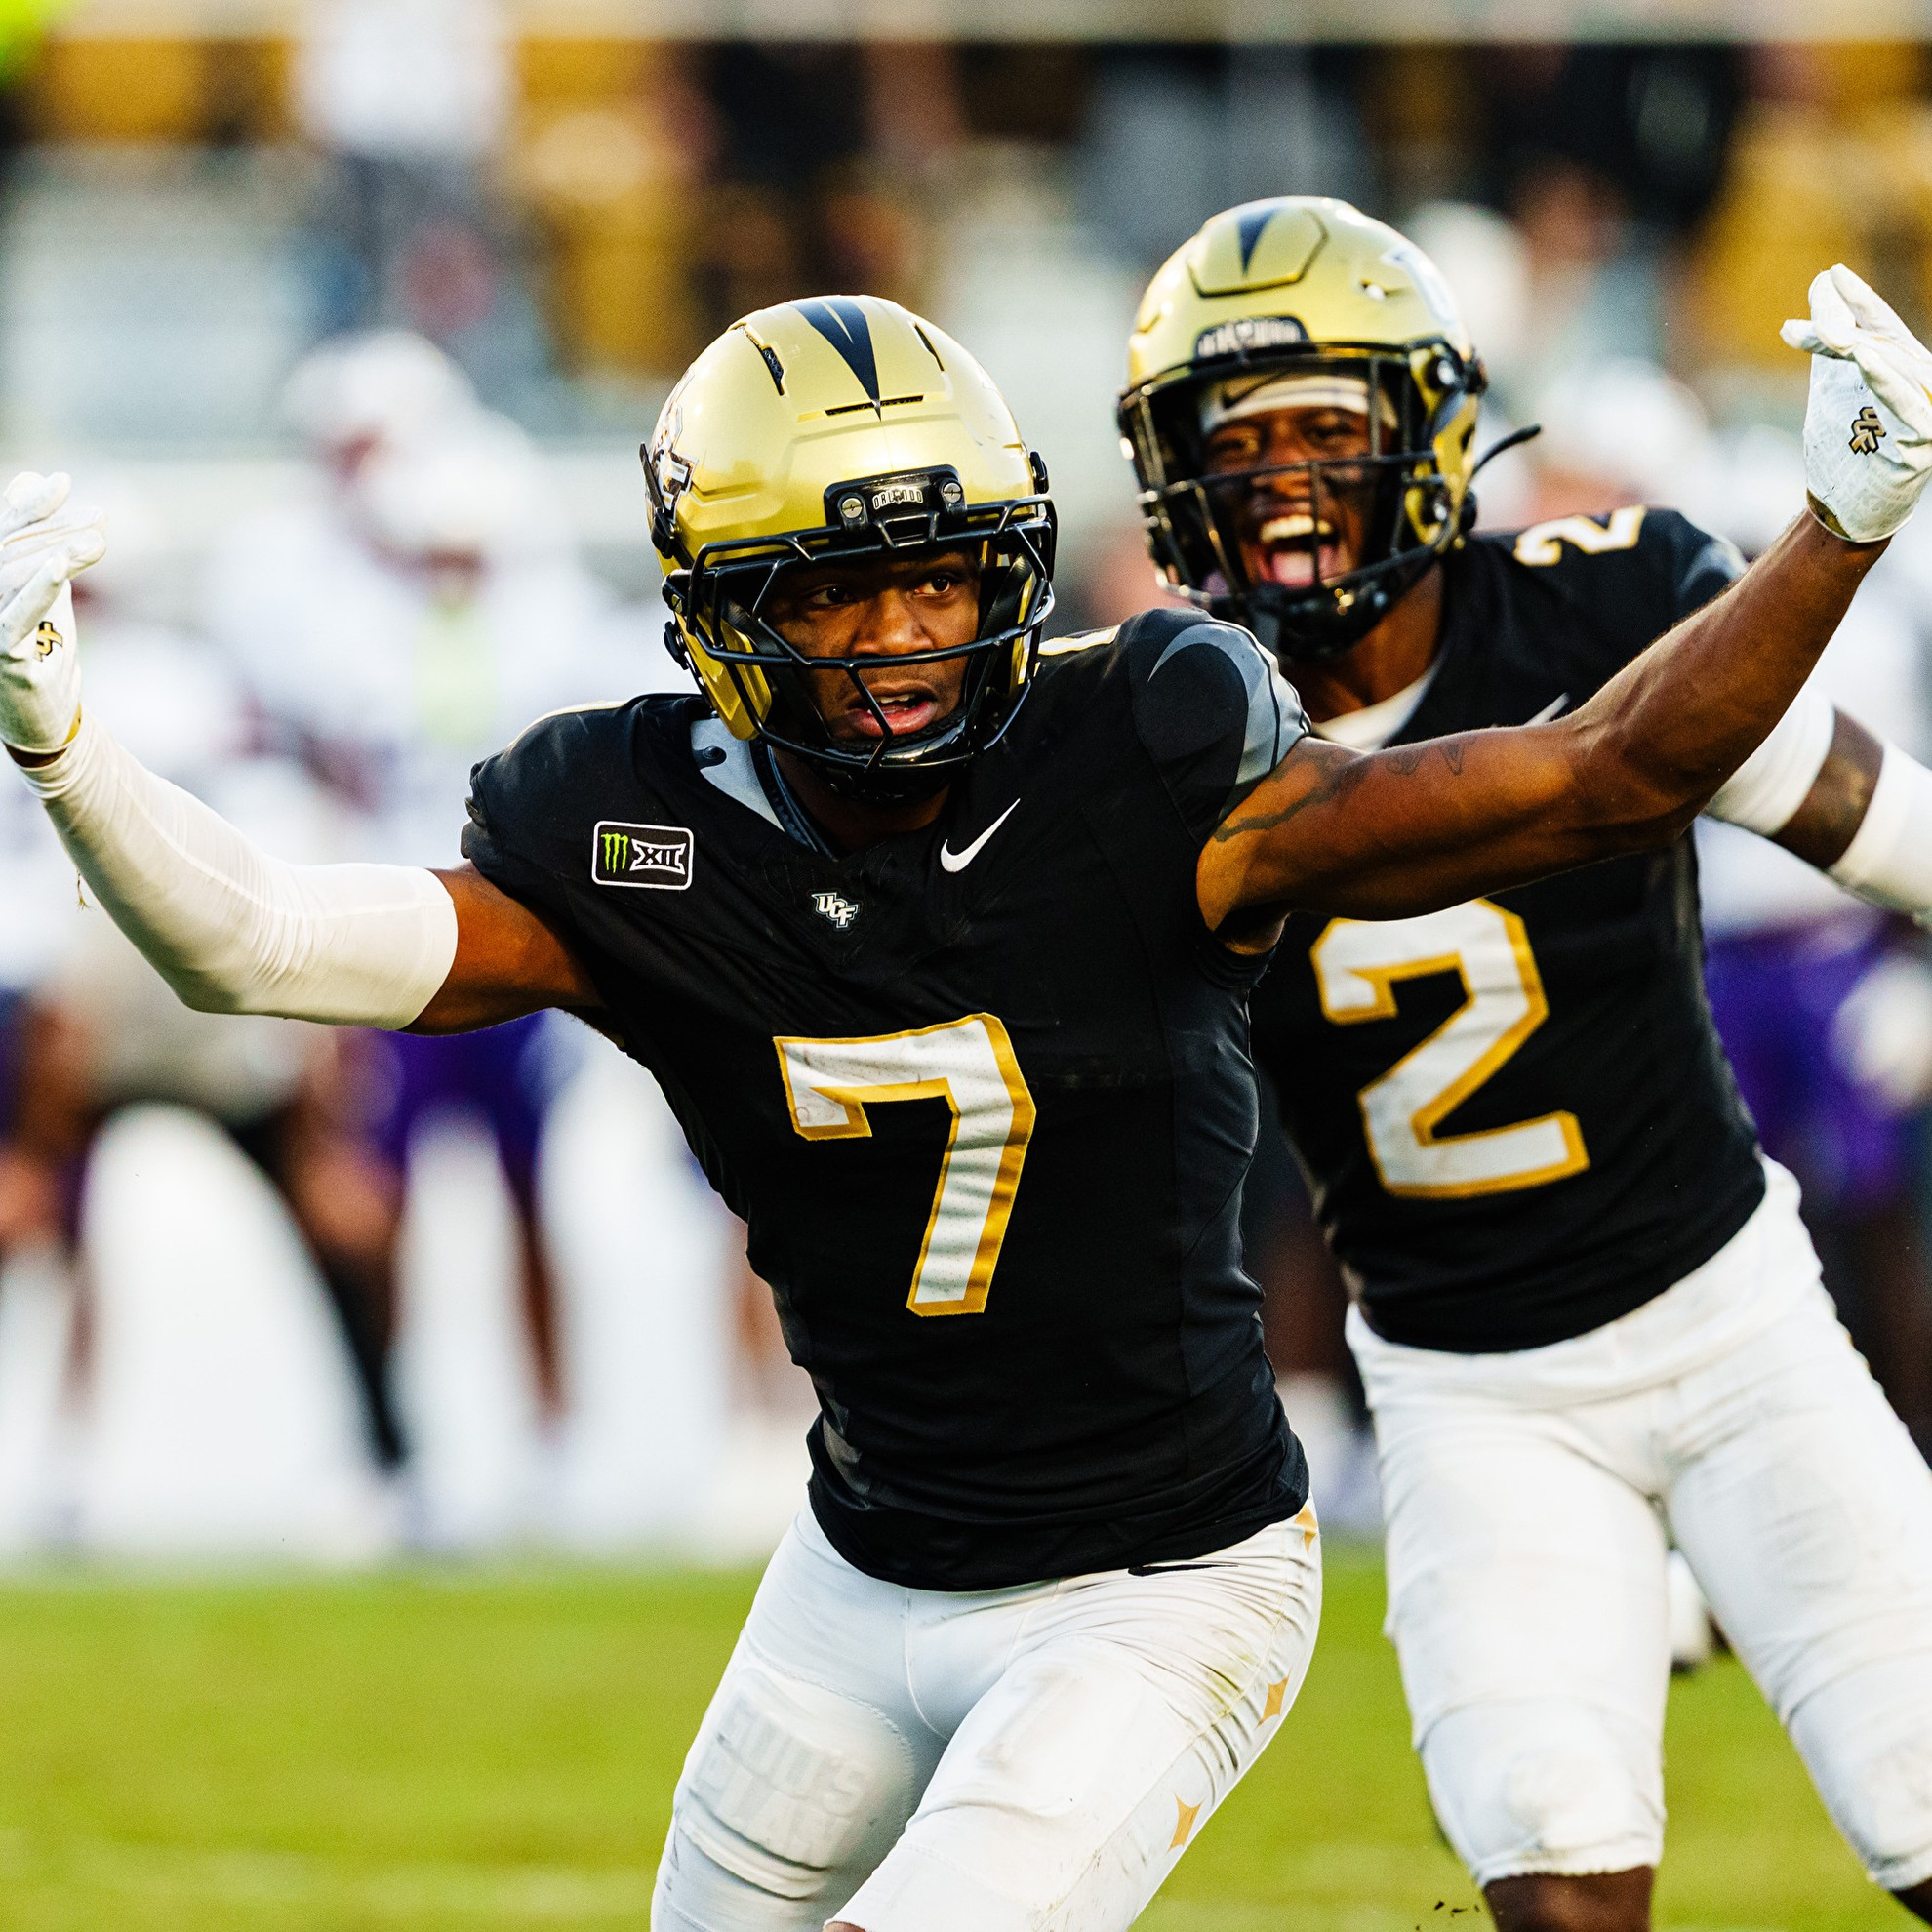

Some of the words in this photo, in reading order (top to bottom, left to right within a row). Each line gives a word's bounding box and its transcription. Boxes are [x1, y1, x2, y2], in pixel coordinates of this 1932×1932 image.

[872, 488, 924, 510] ORLNDO
[1513, 504, 1647, 566] 2
[811, 892, 859, 928] UCF
[1308, 897, 1590, 1199] 2
[772, 1012, 1036, 1317] 7
